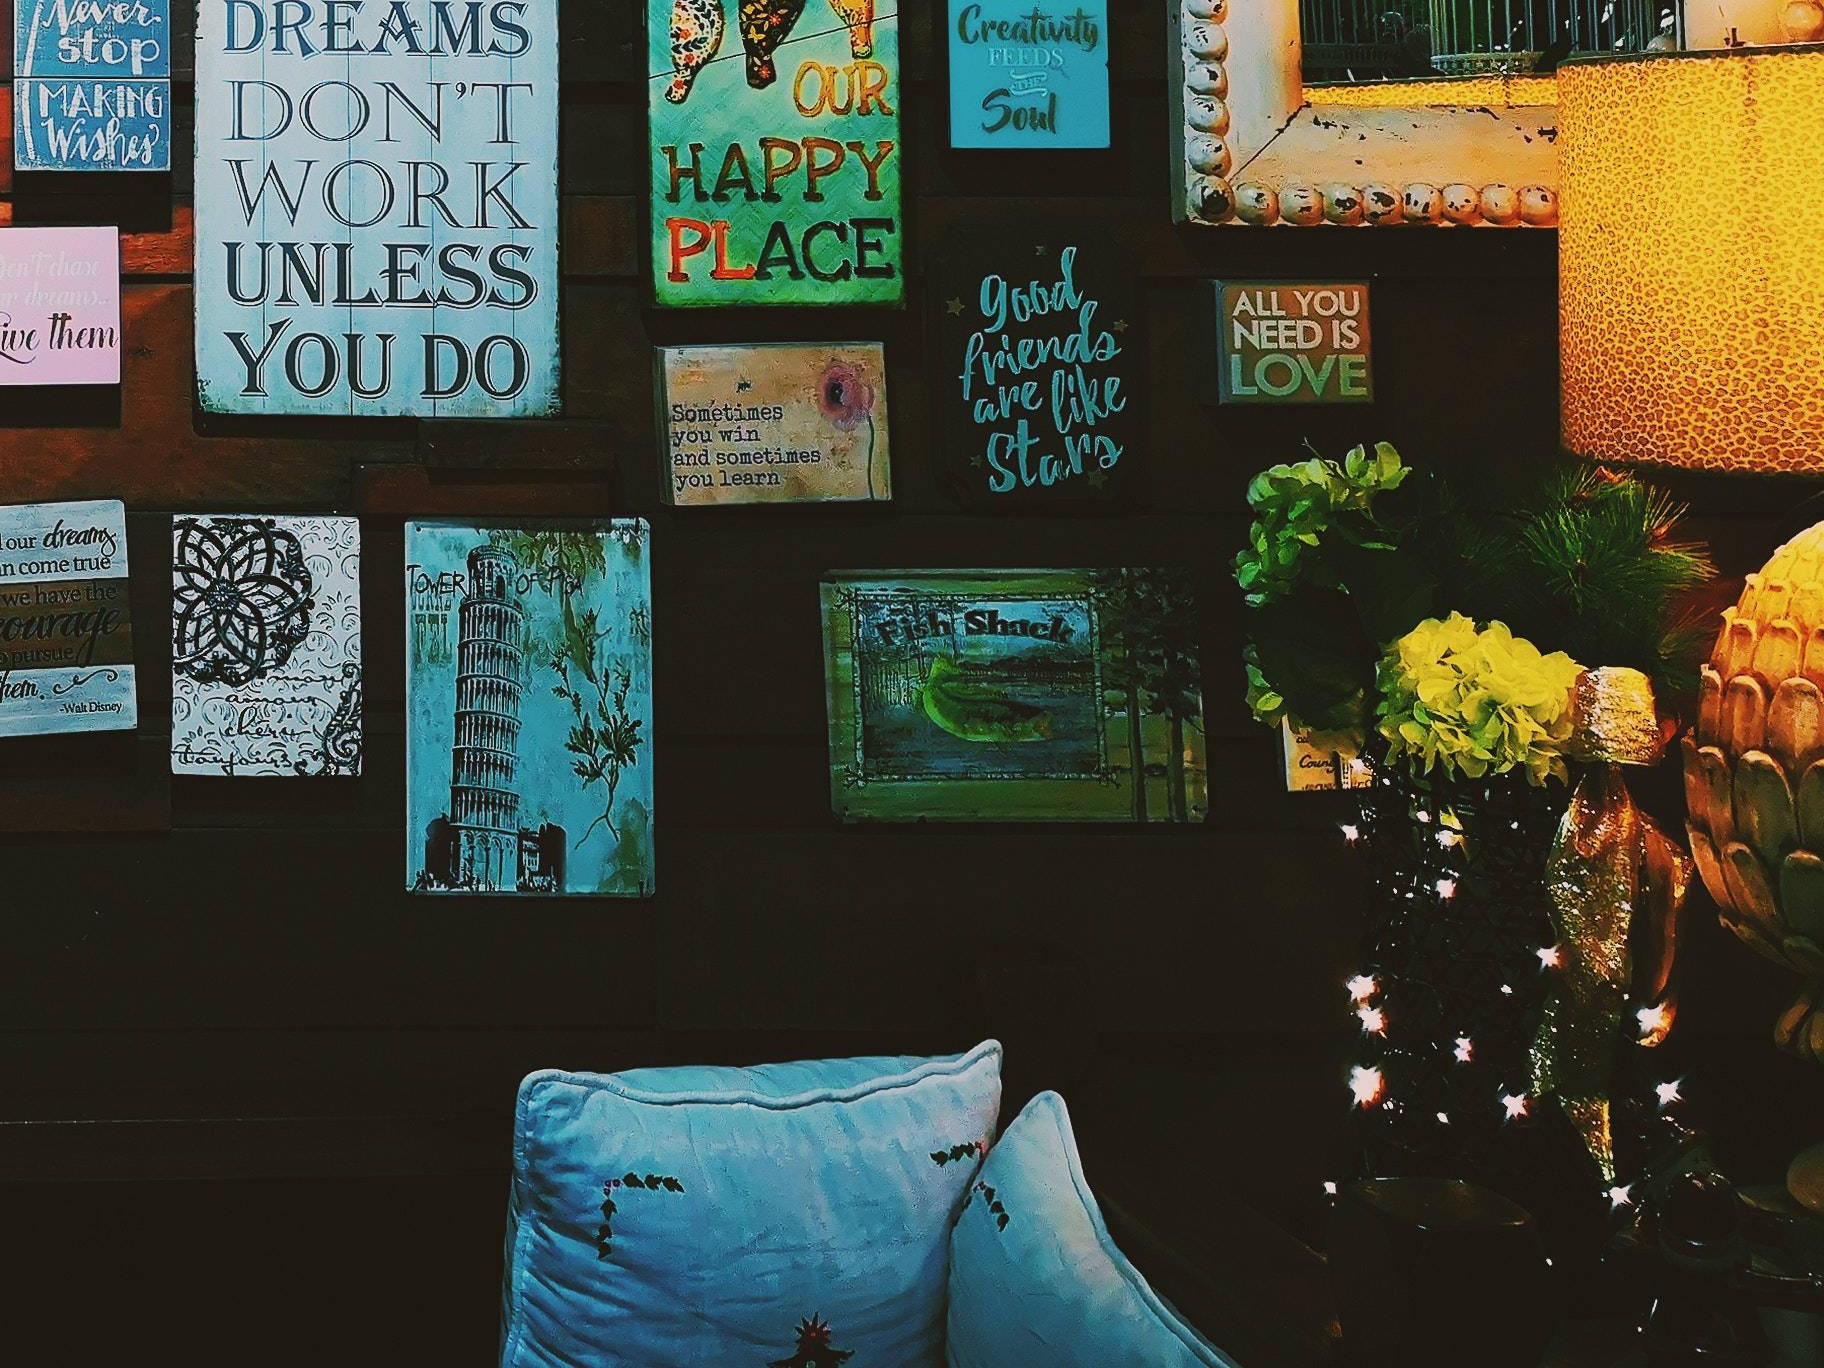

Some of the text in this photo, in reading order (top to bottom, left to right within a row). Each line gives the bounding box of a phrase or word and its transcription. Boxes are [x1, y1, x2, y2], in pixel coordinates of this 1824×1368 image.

[223, 0, 531, 60] DREAMS
[224, 80, 533, 144] DON'T
[662, 137, 894, 202] HAPPY
[223, 159, 538, 229] WORK
[665, 219, 895, 283] PLACE
[223, 242, 538, 309] UNLESS
[1233, 291, 1360, 316] ALL YOU
[1233, 322, 1360, 349] NEED IS
[223, 317, 530, 399] YOU DO
[1230, 354, 1367, 396] LOVE
[672, 404, 783, 421] Sometimes
[672, 426, 760, 445] you win
[20, 557, 69, 576] come
[73, 556, 111, 572] true
[964, 610, 1074, 641] Shack
[89, 702, 122, 712] Disney
